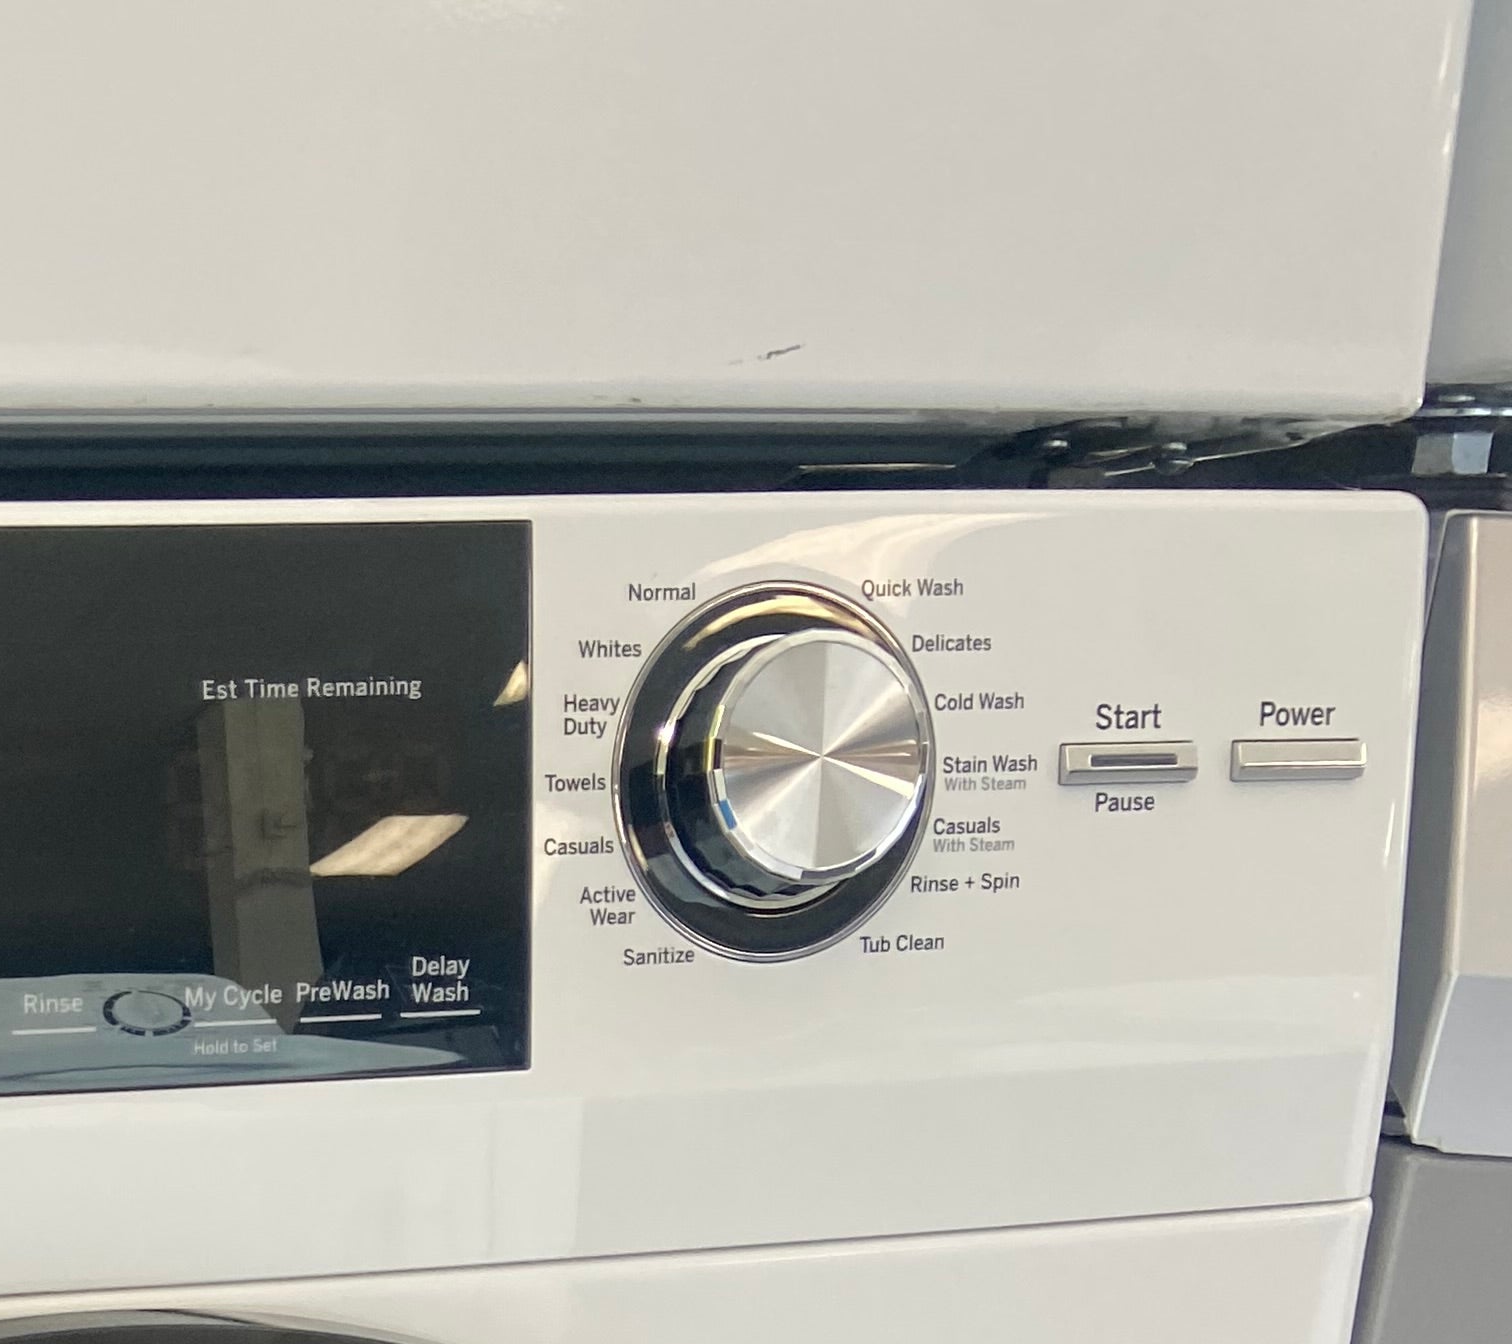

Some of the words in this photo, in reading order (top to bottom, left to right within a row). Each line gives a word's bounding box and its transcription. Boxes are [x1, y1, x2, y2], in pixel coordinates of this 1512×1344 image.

[628, 582, 696, 601] Normal
[861, 579, 912, 601] Quick
[917, 578, 963, 597] Wash
[578, 640, 642, 658] Whites
[912, 634, 992, 652] Delicates
[202, 679, 237, 700] Est
[244, 679, 299, 698] Time
[306, 676, 422, 699] Remaining
[564, 694, 620, 715] Heavy
[934, 693, 973, 711] Cold
[979, 692, 1024, 710] Wash
[1095, 703, 1162, 730] Start
[1259, 701, 1336, 727] Power
[564, 718, 607, 738] Duty
[943, 756, 987, 774] Stain
[992, 754, 1038, 772] Wash
[545, 773, 606, 792] Towels
[944, 777, 976, 791] With
[981, 777, 1026, 790] Steam
[1095, 792, 1155, 812] Pause
[933, 816, 1001, 835] Casuals
[544, 836, 614, 856] Casuals
[933, 838, 965, 852] With
[969, 837, 1015, 852] Steam
[911, 876, 958, 893] Rinse
[981, 872, 1020, 893] Spin
[580, 886, 636, 904] Active
[590, 908, 636, 925] Wear
[860, 936, 890, 953] Tub
[896, 935, 944, 951] Clean
[623, 947, 695, 966] Sanitize
[412, 955, 470, 979] Delay
[186, 986, 216, 1010] My
[223, 984, 283, 1007] Cycle
[296, 980, 390, 1003] PreWash
[413, 981, 470, 1003] Wash
[24, 993, 83, 1014] Rinse
[194, 1038, 229, 1056] Hold
[234, 1040, 248, 1054] to
[253, 1038, 278, 1053] Set
